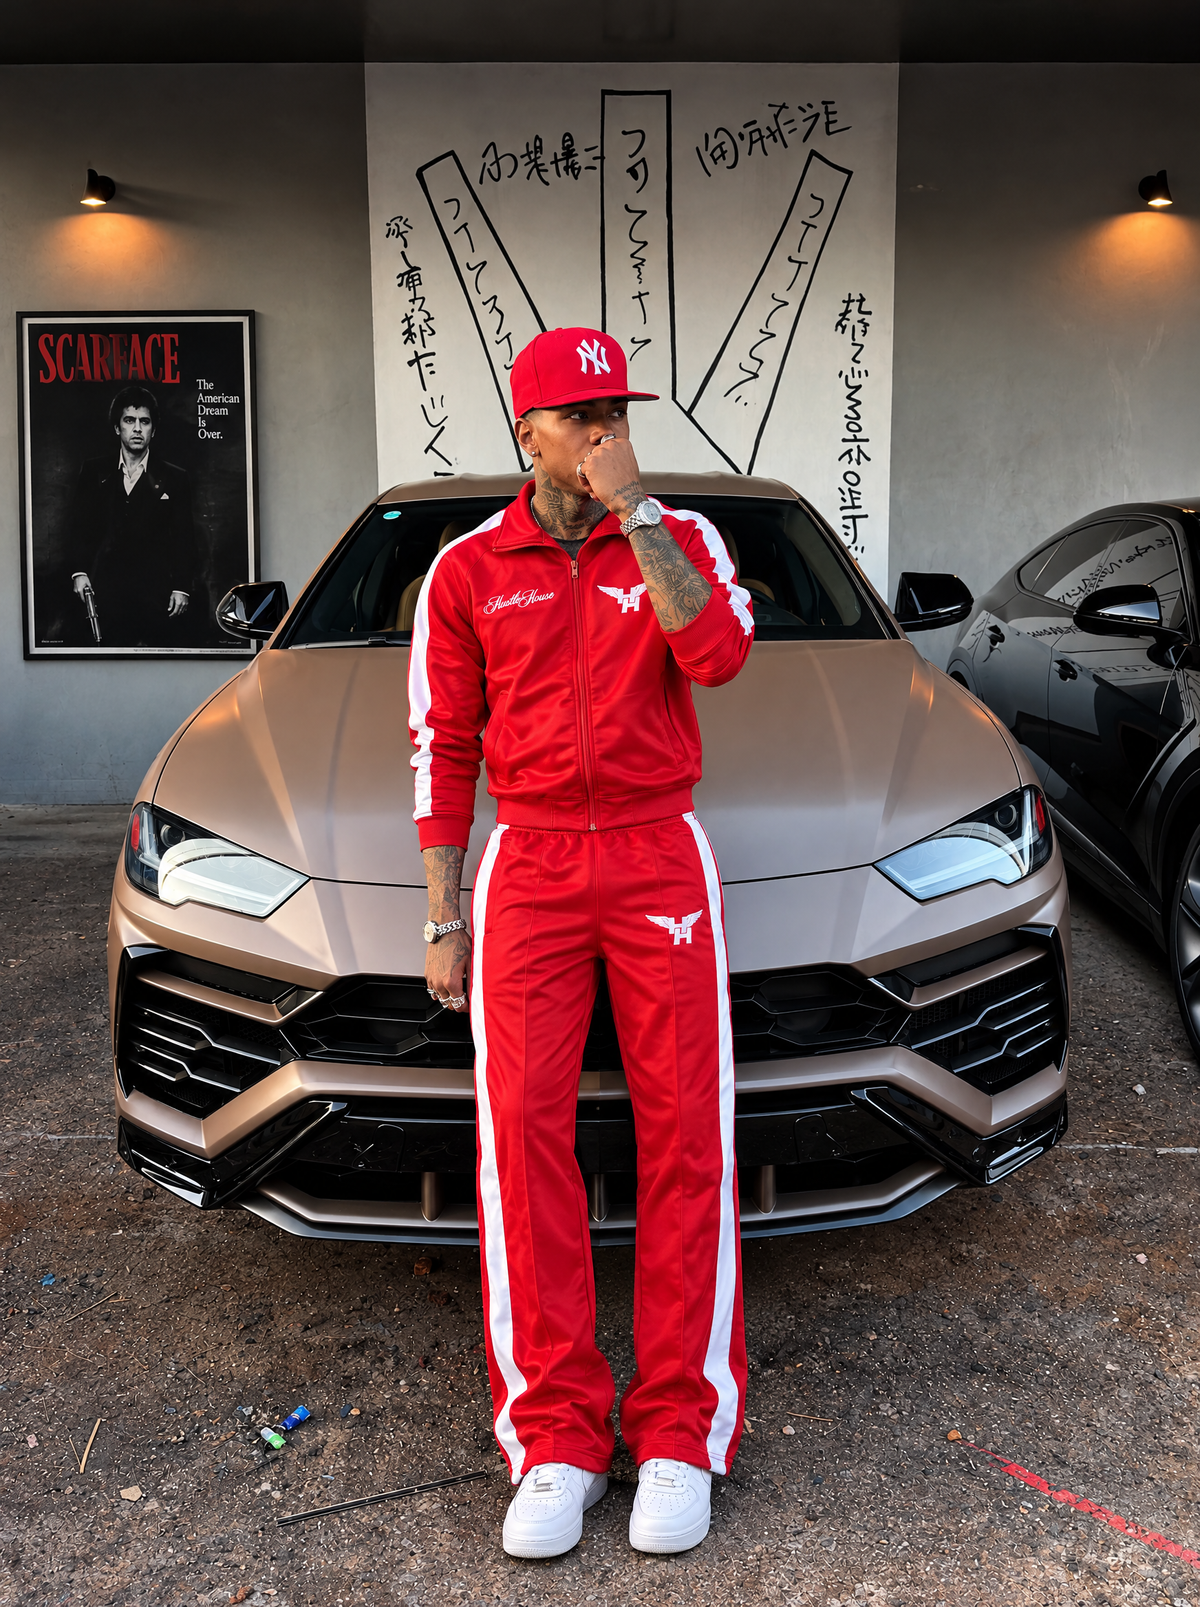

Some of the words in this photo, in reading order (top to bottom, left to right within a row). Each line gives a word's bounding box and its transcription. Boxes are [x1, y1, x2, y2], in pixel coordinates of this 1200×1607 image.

[38, 333, 180, 383] SCARFACE
[576, 338, 611, 375] NY
[196, 378, 215, 390] The
[196, 392, 240, 404] American
[197, 404, 229, 416] Dream
[198, 416, 206, 427] Is
[198, 428, 223, 439] Over.
